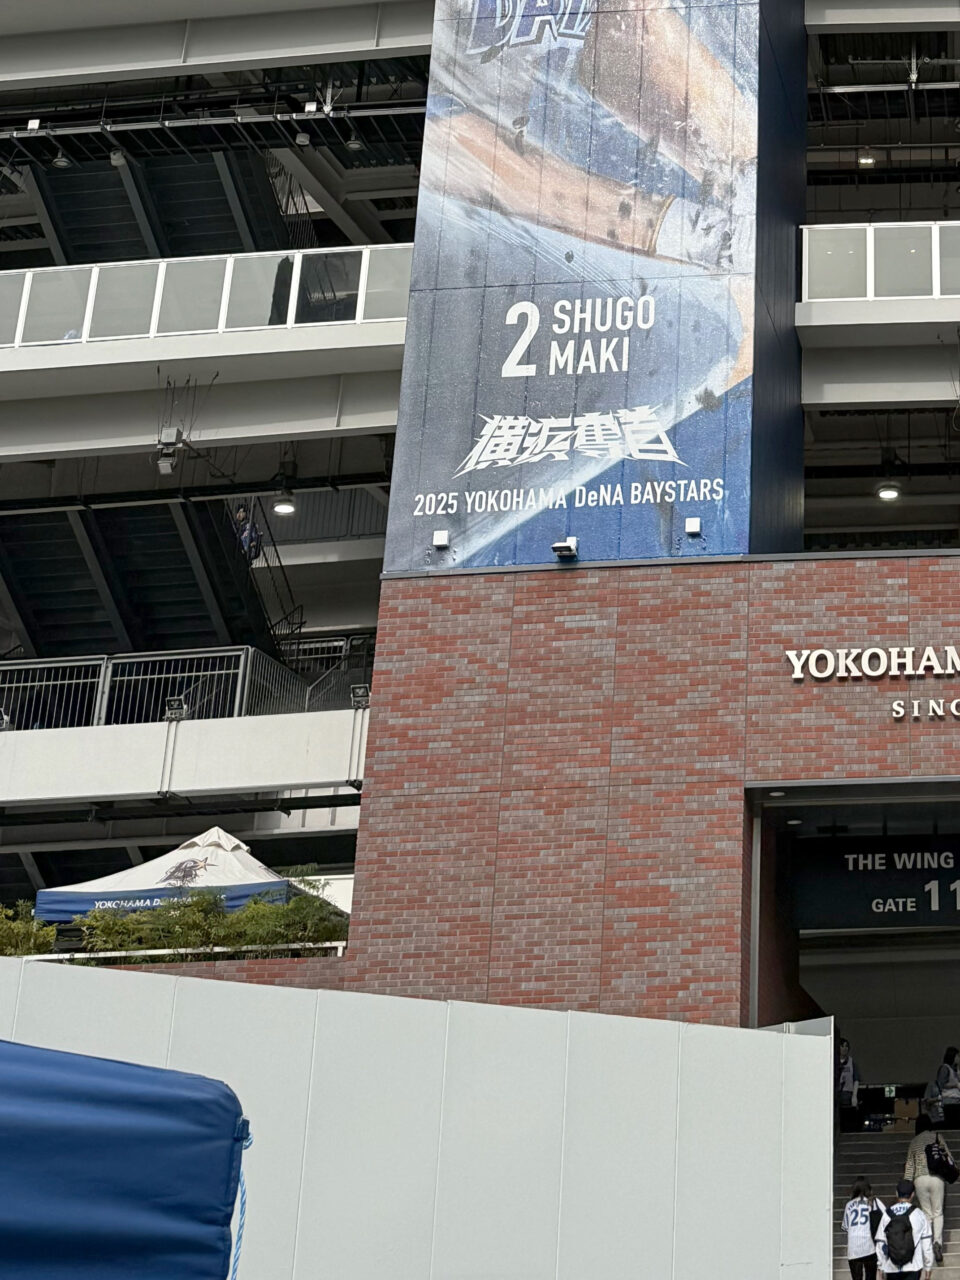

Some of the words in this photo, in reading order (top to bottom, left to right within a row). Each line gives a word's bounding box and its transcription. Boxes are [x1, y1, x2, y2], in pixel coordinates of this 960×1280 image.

[552, 295, 656, 335] SHUGO
[501, 300, 541, 378] 2
[548, 336, 630, 376] MAKI
[413, 492, 458, 516] 2025
[465, 487, 567, 514] YOKOHAMA
[574, 485, 624, 508] DeNA
[630, 479, 724, 504] BAYSTARS
[844, 853, 887, 871] THE
[893, 851, 955, 869] WING
[871, 897, 917, 913] GATE
[850, 1208, 869, 1227] 25
